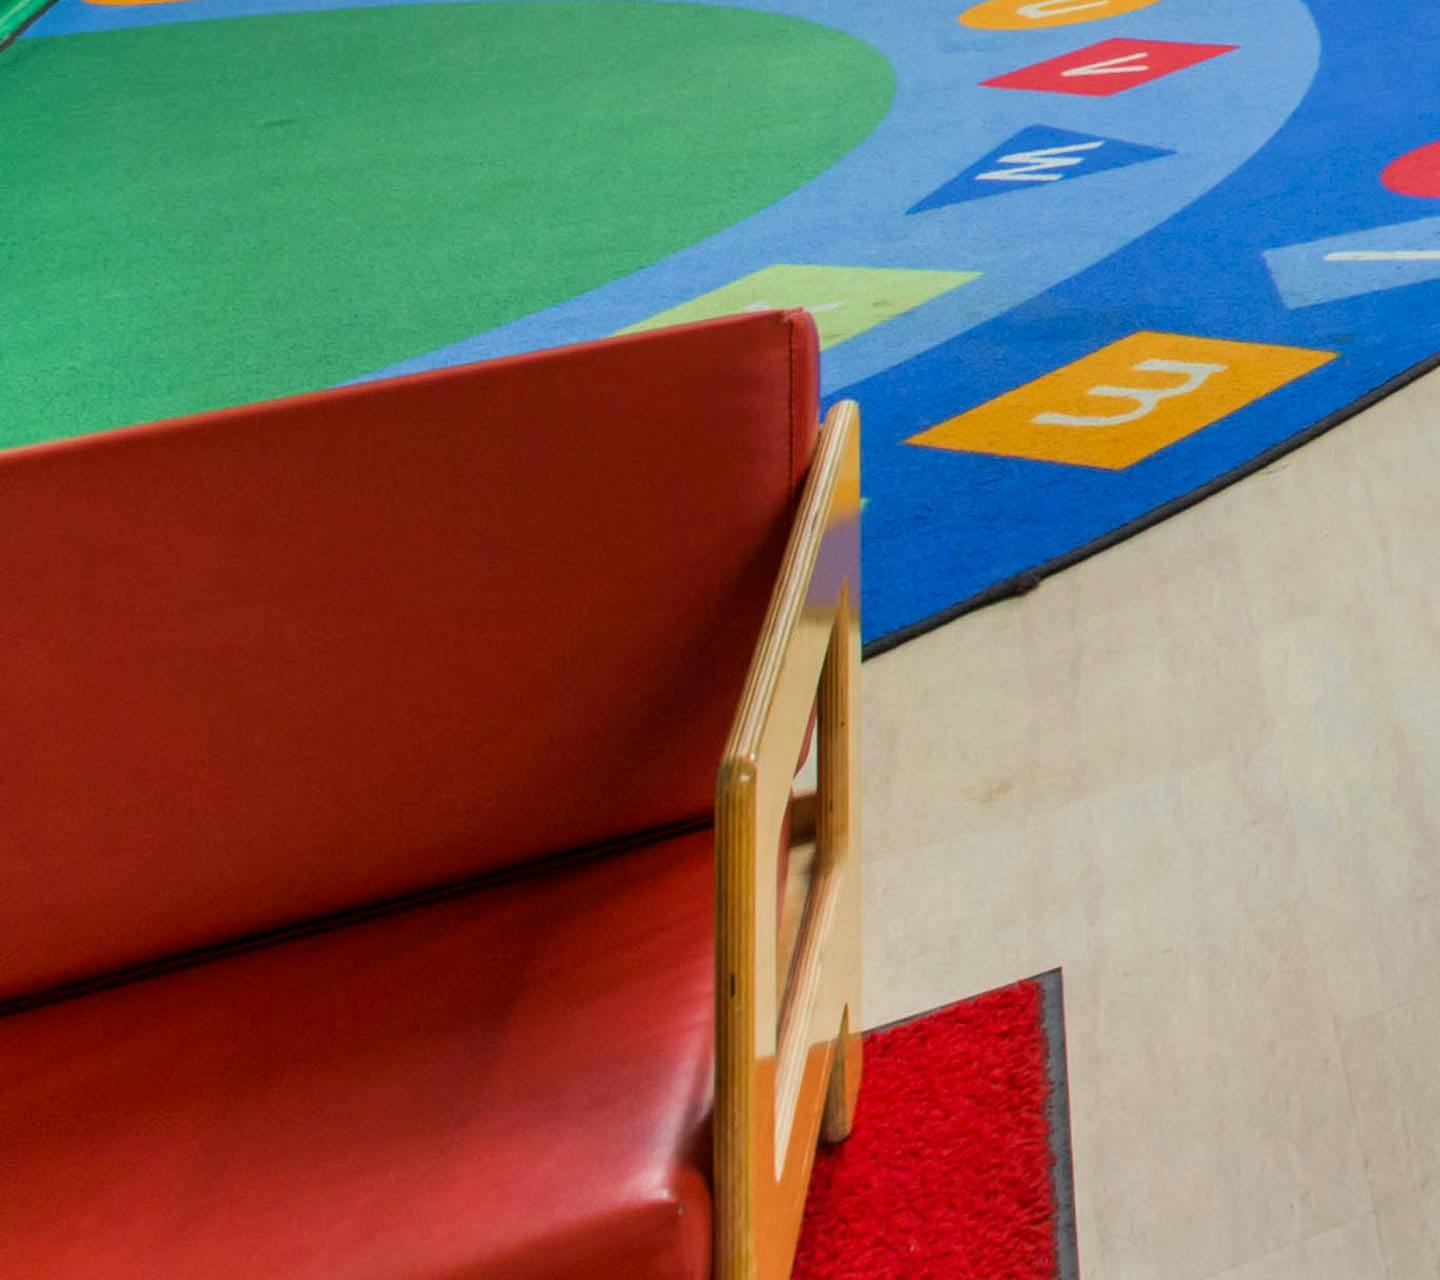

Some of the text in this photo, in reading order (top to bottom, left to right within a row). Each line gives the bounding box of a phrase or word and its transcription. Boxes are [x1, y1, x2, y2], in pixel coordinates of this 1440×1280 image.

[1061, 52, 1149, 77] v
[975, 141, 1103, 181] w
[1032, 357, 1230, 428] m
